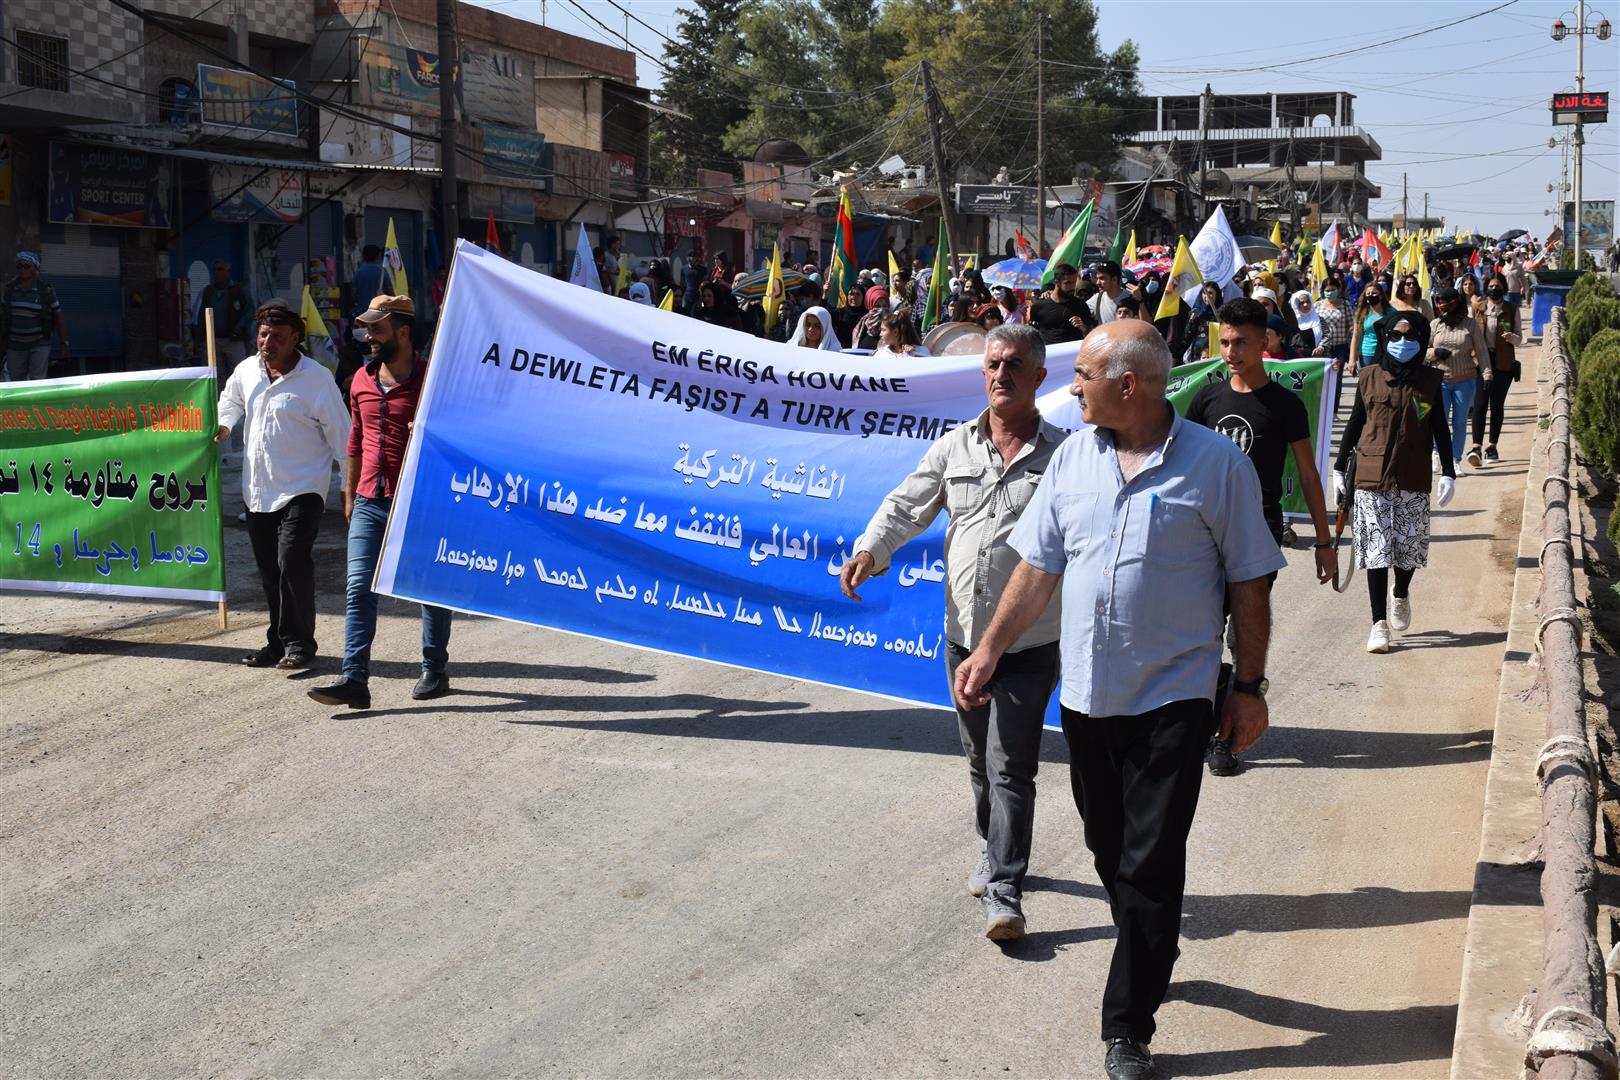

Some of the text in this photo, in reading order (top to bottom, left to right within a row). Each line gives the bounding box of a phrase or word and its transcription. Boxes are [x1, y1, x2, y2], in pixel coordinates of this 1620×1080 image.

[81, 188, 145, 205] SPORT CENTER
[652, 340, 689, 368] EM
[787, 370, 910, 393] HOVANE
[481, 343, 501, 367] A
[509, 347, 640, 397] DEWLETA
[648, 377, 746, 412] FAŞIST
[750, 397, 770, 420] A
[780, 399, 856, 431] TURK
[139, 400, 203, 433] Têkbibin
[30, 460, 55, 496] ١٤
[63, 458, 140, 509] مقاومة
[450, 465, 530, 513] الإرهاب
[673, 441, 847, 500] الفاشية التركية
[148, 471, 209, 512] بروح
[539, 480, 579, 516] هذا
[584, 496, 627, 526] ضد
[633, 501, 668, 533] معا
[674, 505, 743, 550] فلنقف
[14, 521, 41, 557] 14
[749, 522, 819, 567] العالمي
[898, 548, 946, 588] على
